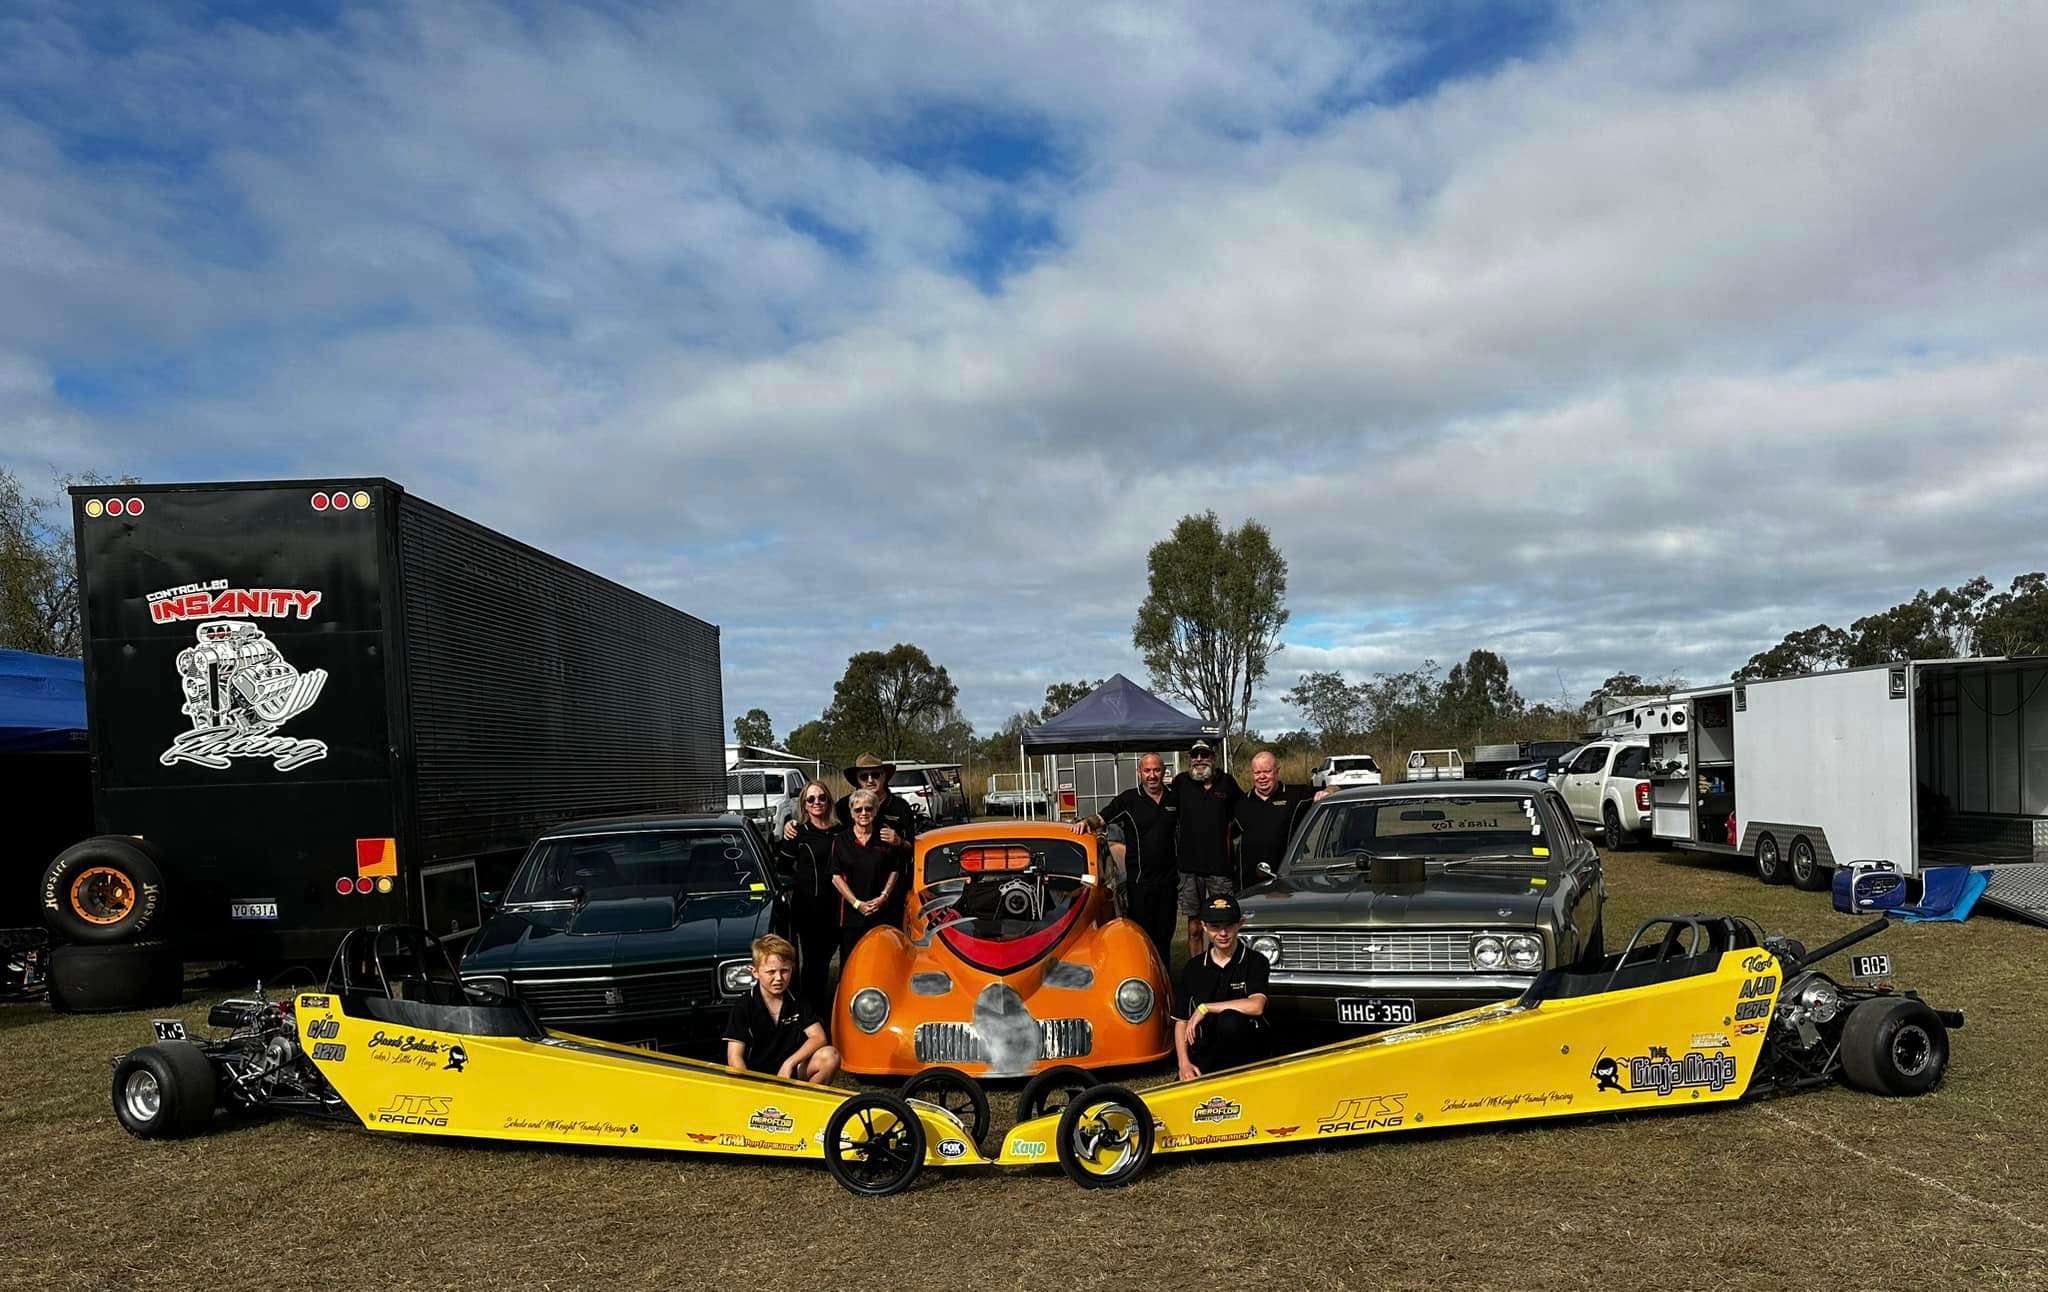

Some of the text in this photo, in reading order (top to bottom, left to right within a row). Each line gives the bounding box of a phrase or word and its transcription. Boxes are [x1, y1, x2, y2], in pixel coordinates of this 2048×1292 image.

[146, 579, 228, 601] CONTROLLED
[149, 589, 321, 624] INSANITY
[160, 726, 327, 771] Racing
[1861, 955, 1888, 975] 8.03
[1739, 976, 1776, 998] A/JD
[1735, 999, 1771, 1021] 9275
[1631, 1052, 1736, 1097] Ginja Ninja
[379, 1094, 453, 1116] JTS
[1317, 1093, 1408, 1123] JTS
[379, 1114, 449, 1127] RACING
[1318, 1116, 1404, 1134] RACING
[943, 1142, 961, 1153] FOX
[1012, 1141, 1045, 1157] Kayo
